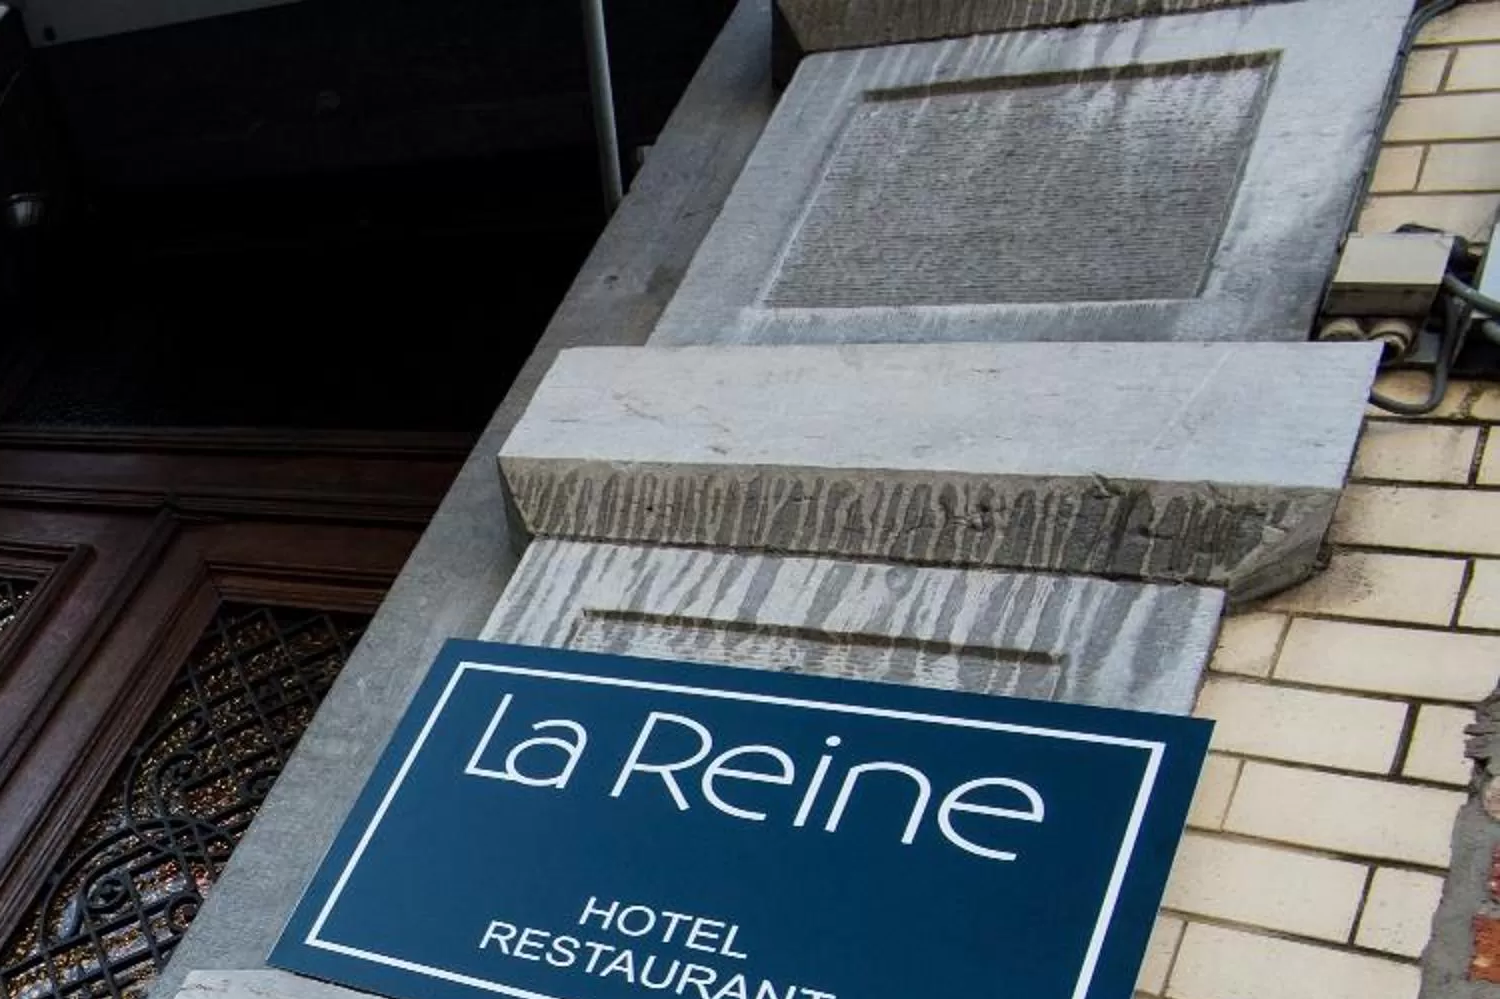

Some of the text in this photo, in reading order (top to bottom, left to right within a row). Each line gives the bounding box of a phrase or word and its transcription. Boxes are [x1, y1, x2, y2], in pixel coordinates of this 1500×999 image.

[464, 693, 1045, 861] La Reine
[579, 896, 747, 959] HOTEL
